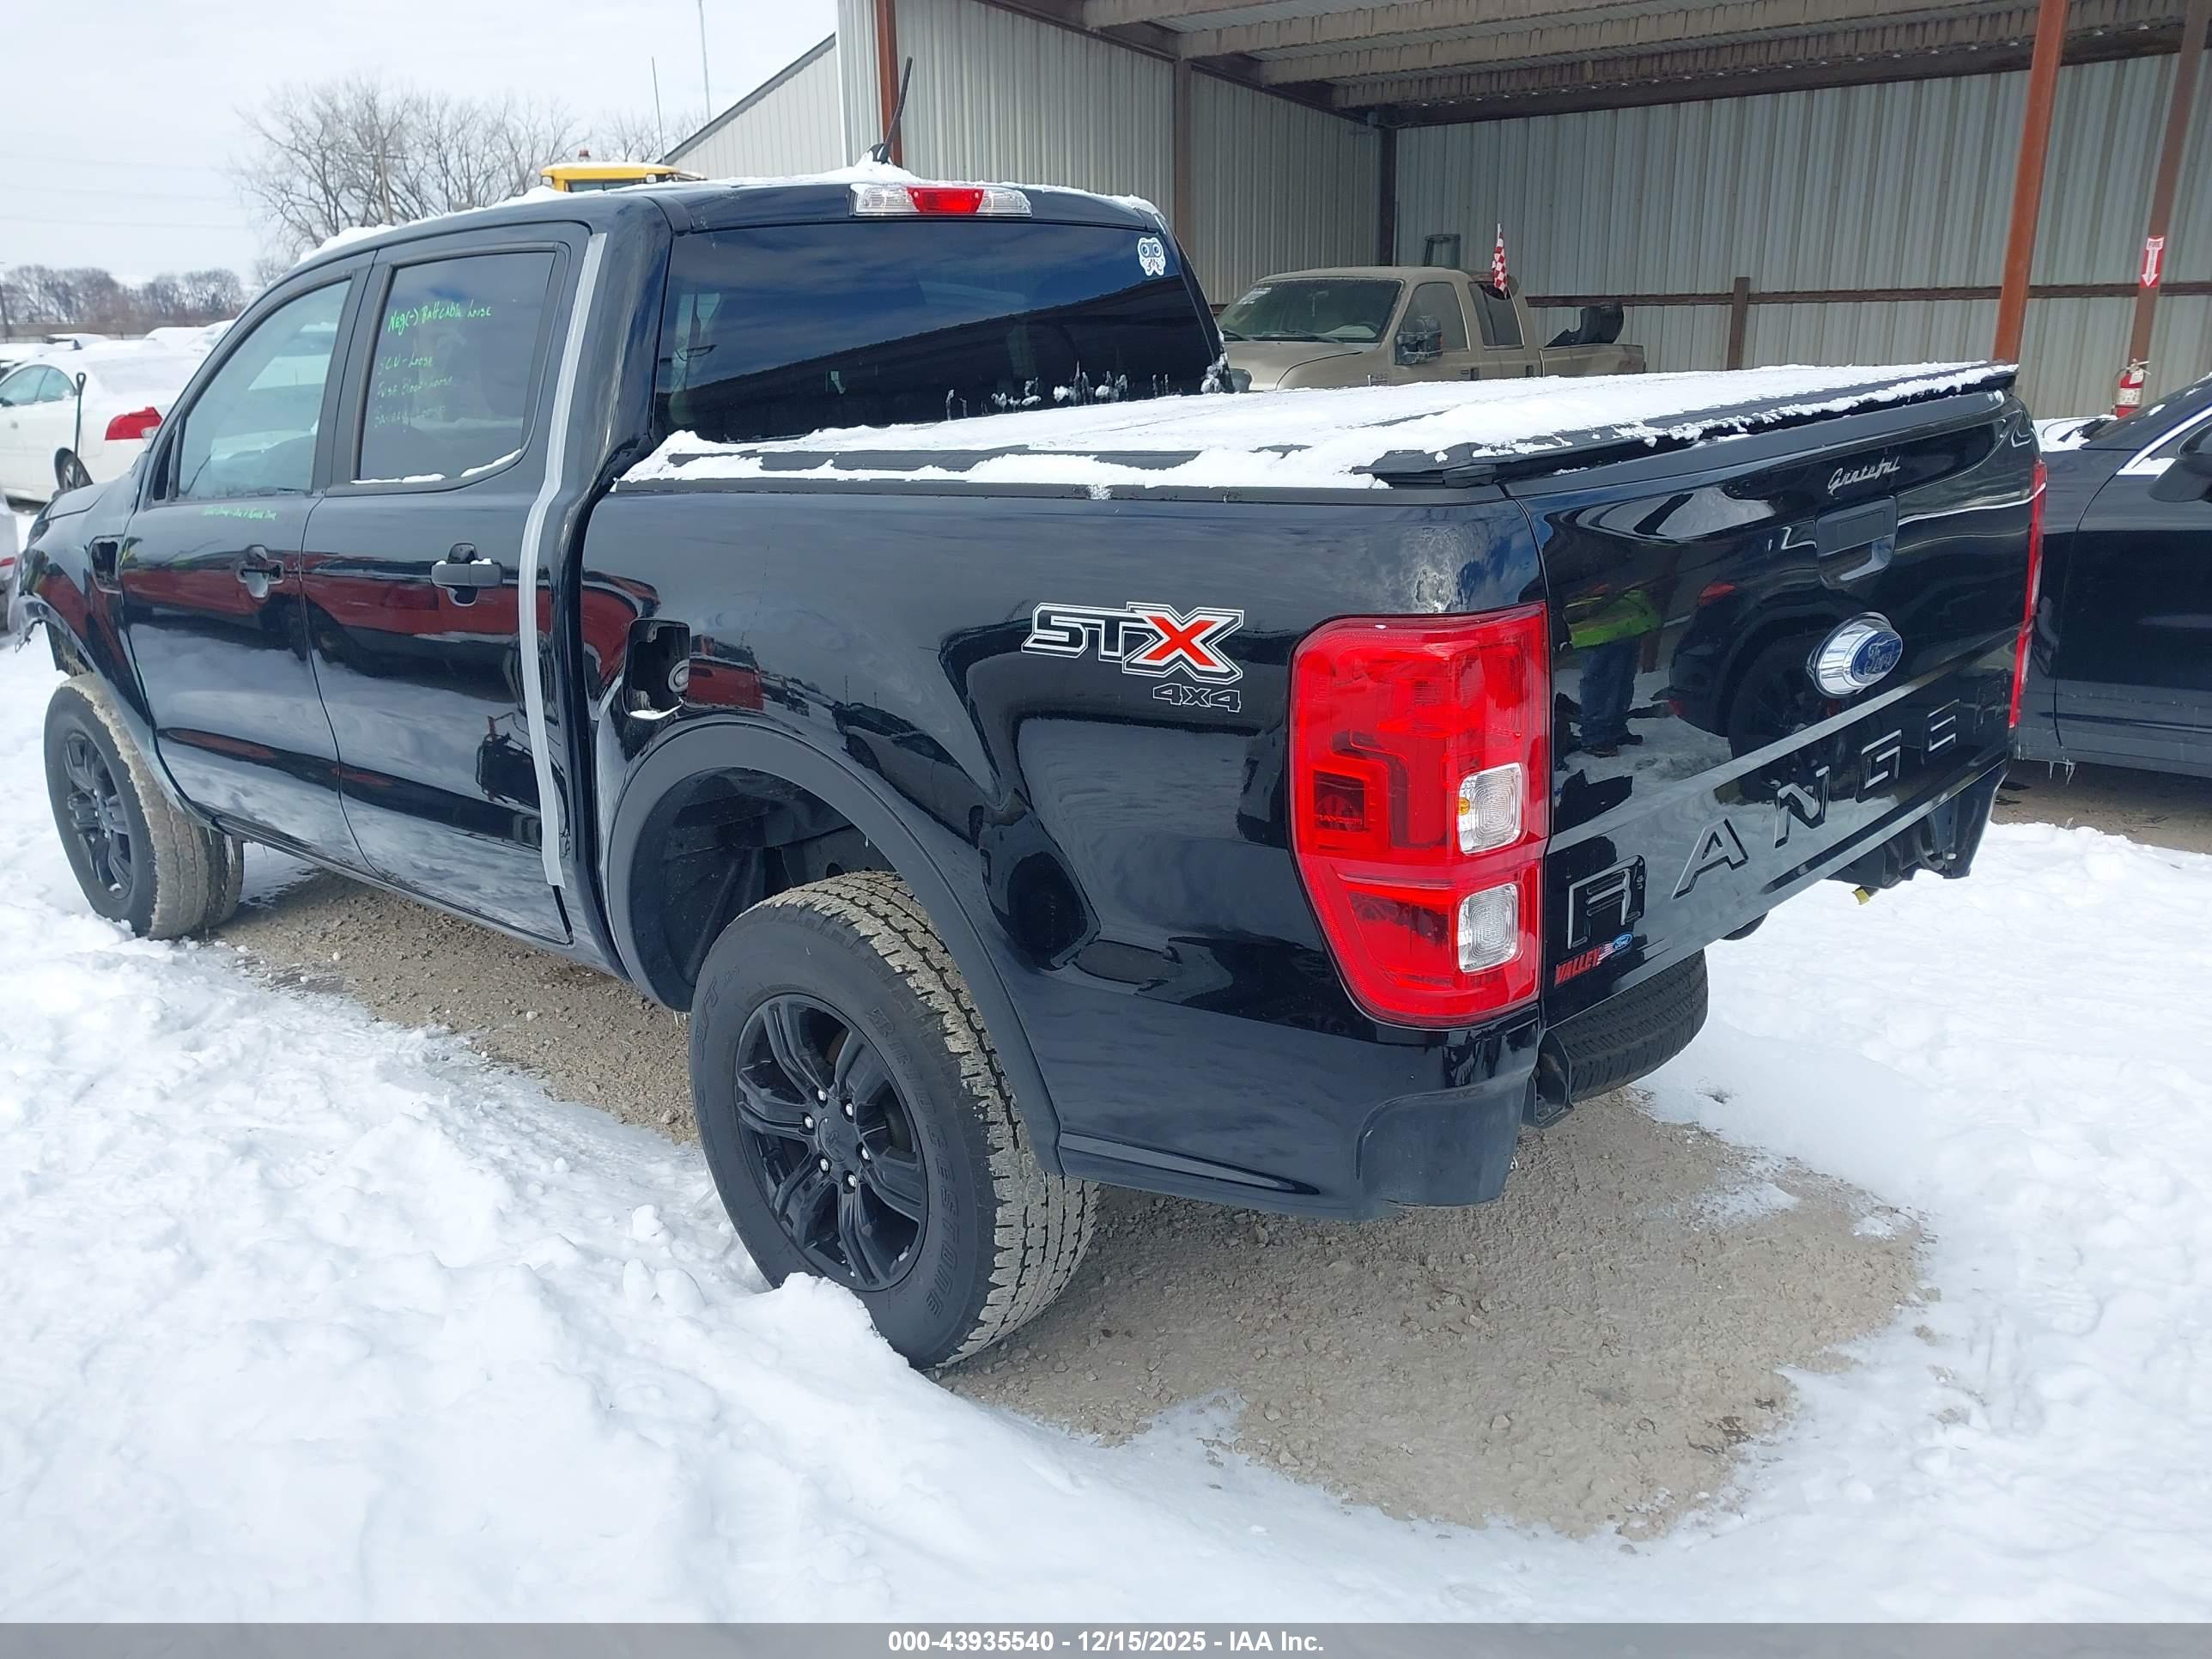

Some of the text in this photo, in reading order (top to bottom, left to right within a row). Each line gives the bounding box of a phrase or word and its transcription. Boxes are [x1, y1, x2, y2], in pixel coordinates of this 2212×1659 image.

[1021, 601, 1244, 684] STX
[1566, 668, 2008, 950] RANGER
[1554, 947, 1601, 987] VALLEY
[866, 1007, 959, 1318] BRIDGESTONE
